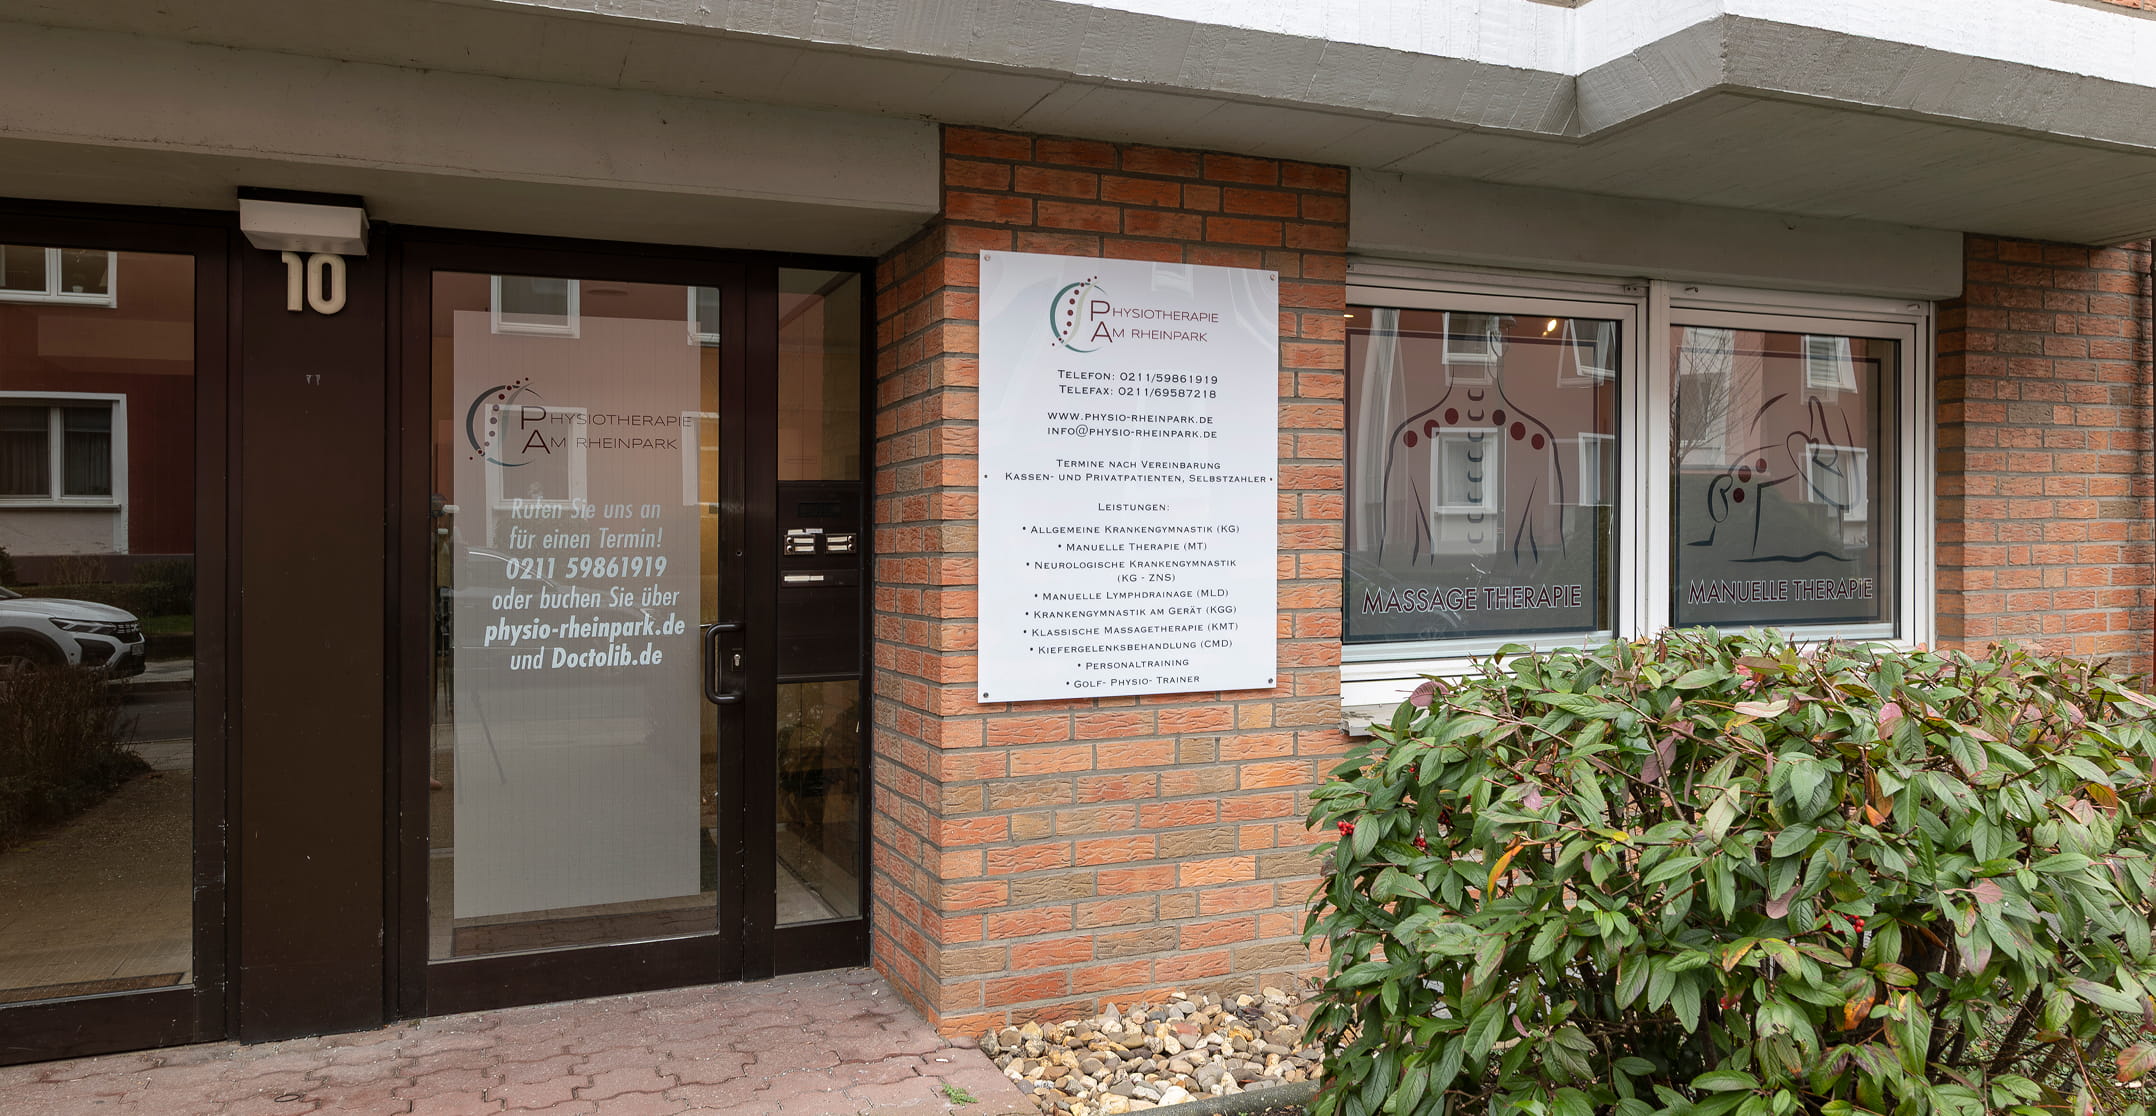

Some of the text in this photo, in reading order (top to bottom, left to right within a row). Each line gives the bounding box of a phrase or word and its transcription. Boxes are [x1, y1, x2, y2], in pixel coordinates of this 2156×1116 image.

[282, 250, 346, 315] 10
[1090, 300, 1220, 323] PHYSIOTHERAPIE
[1091, 321, 1208, 343] AM RHEINPARK
[1057, 369, 1218, 385] TELEFON: 0211/59861919
[1059, 385, 1217, 399] TELEFAX: 0211/69587218
[520, 405, 692, 431] PHYSIOTHERAPIE
[1047, 412, 1213, 424] WWW.PHYSIO-RHEINPARK.DE
[1047, 425, 1217, 439] INFO@PHYSIO-RHEINPARK.DE
[521, 429, 678, 454] AM RHEINPARK
[1056, 459, 1221, 470] TERMINE NACH VEREINBARUNG
[1005, 472, 1267, 483] KASSEN- UND PRIVATPATIENTEN, SELBSTZAHLER
[511, 497, 661, 519] Rufen Sie uns an
[1098, 503, 1170, 512] LEISTUNGEN:
[1030, 524, 1240, 534] ALLGEMEINE KRANKENGYMNASTIK (KG)
[509, 526, 663, 549] für einen Termin!
[1066, 541, 1207, 552] MANUELLE THERAPIE (MT)
[506, 556, 668, 580] 0211 59861919
[1034, 559, 1237, 570] NEUROLOGISCHE KRANKENGYMNASTIK
[1117, 573, 1137, 583] (KG
[1148, 572, 1176, 583] ZNS)
[492, 584, 681, 610] oder buchen Sie über
[1042, 588, 1229, 601] MANUELLE LYMPHDRAINAGE (MLD)
[1687, 577, 1873, 604] MANUELLE THERAPIE
[1361, 584, 1582, 615] MASSAGE THERAPIE
[1034, 605, 1237, 619] KRANKENGYMNASTIK AM GERÄT (KGG)
[484, 612, 685, 647] physio-rheinpark.de
[1031, 621, 1239, 637] KLASSISCHE MASSAGETHERAPIE (KMT)
[1038, 639, 1233, 655] KIEFERGELENKSBEHANDLUNG (CMD)
[510, 643, 663, 670] und Doctolib.de
[1085, 659, 1189, 670] PERSONALTRAINING
[1073, 675, 1200, 689] GOLF- PHYSIO- TRAINER
